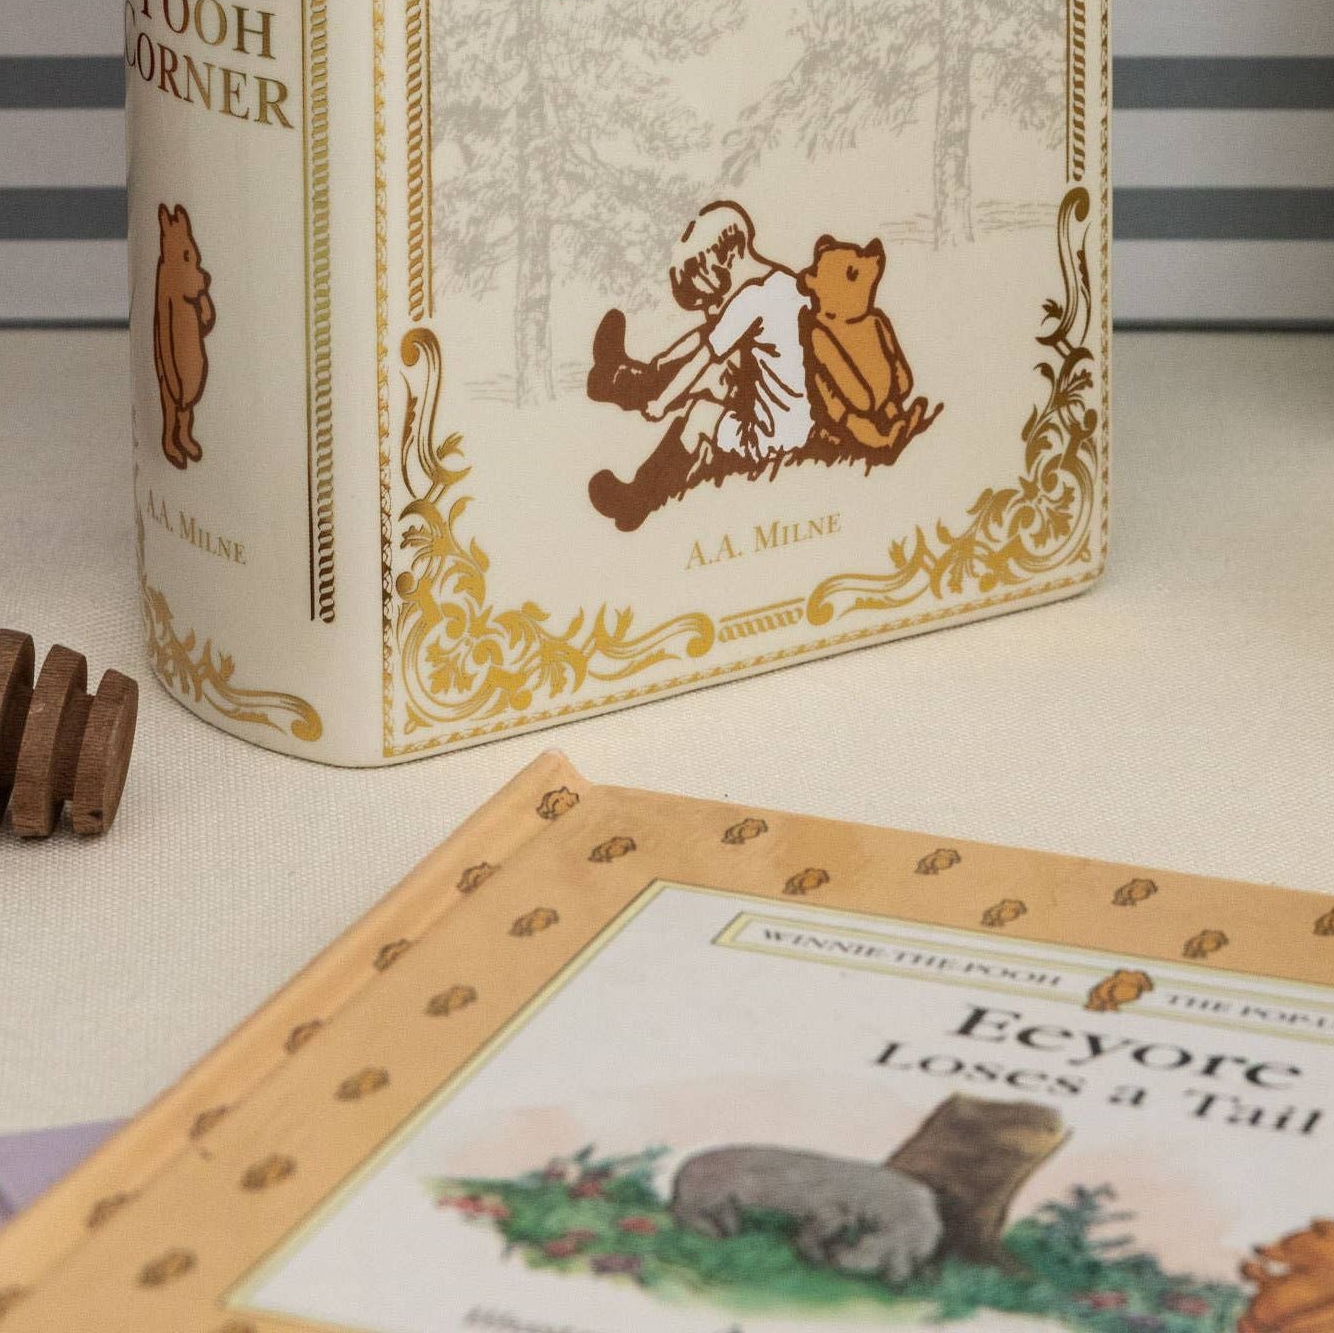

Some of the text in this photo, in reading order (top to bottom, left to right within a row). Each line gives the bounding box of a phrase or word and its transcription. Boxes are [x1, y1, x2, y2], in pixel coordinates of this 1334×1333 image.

[178, 510, 247, 565] MILNE
[684, 512, 843, 570] A.A. MILNE
[1165, 993, 1232, 1015] THE
[951, 1002, 1304, 1091] Eeyore
[871, 1040, 1325, 1136] Loses a Tail
